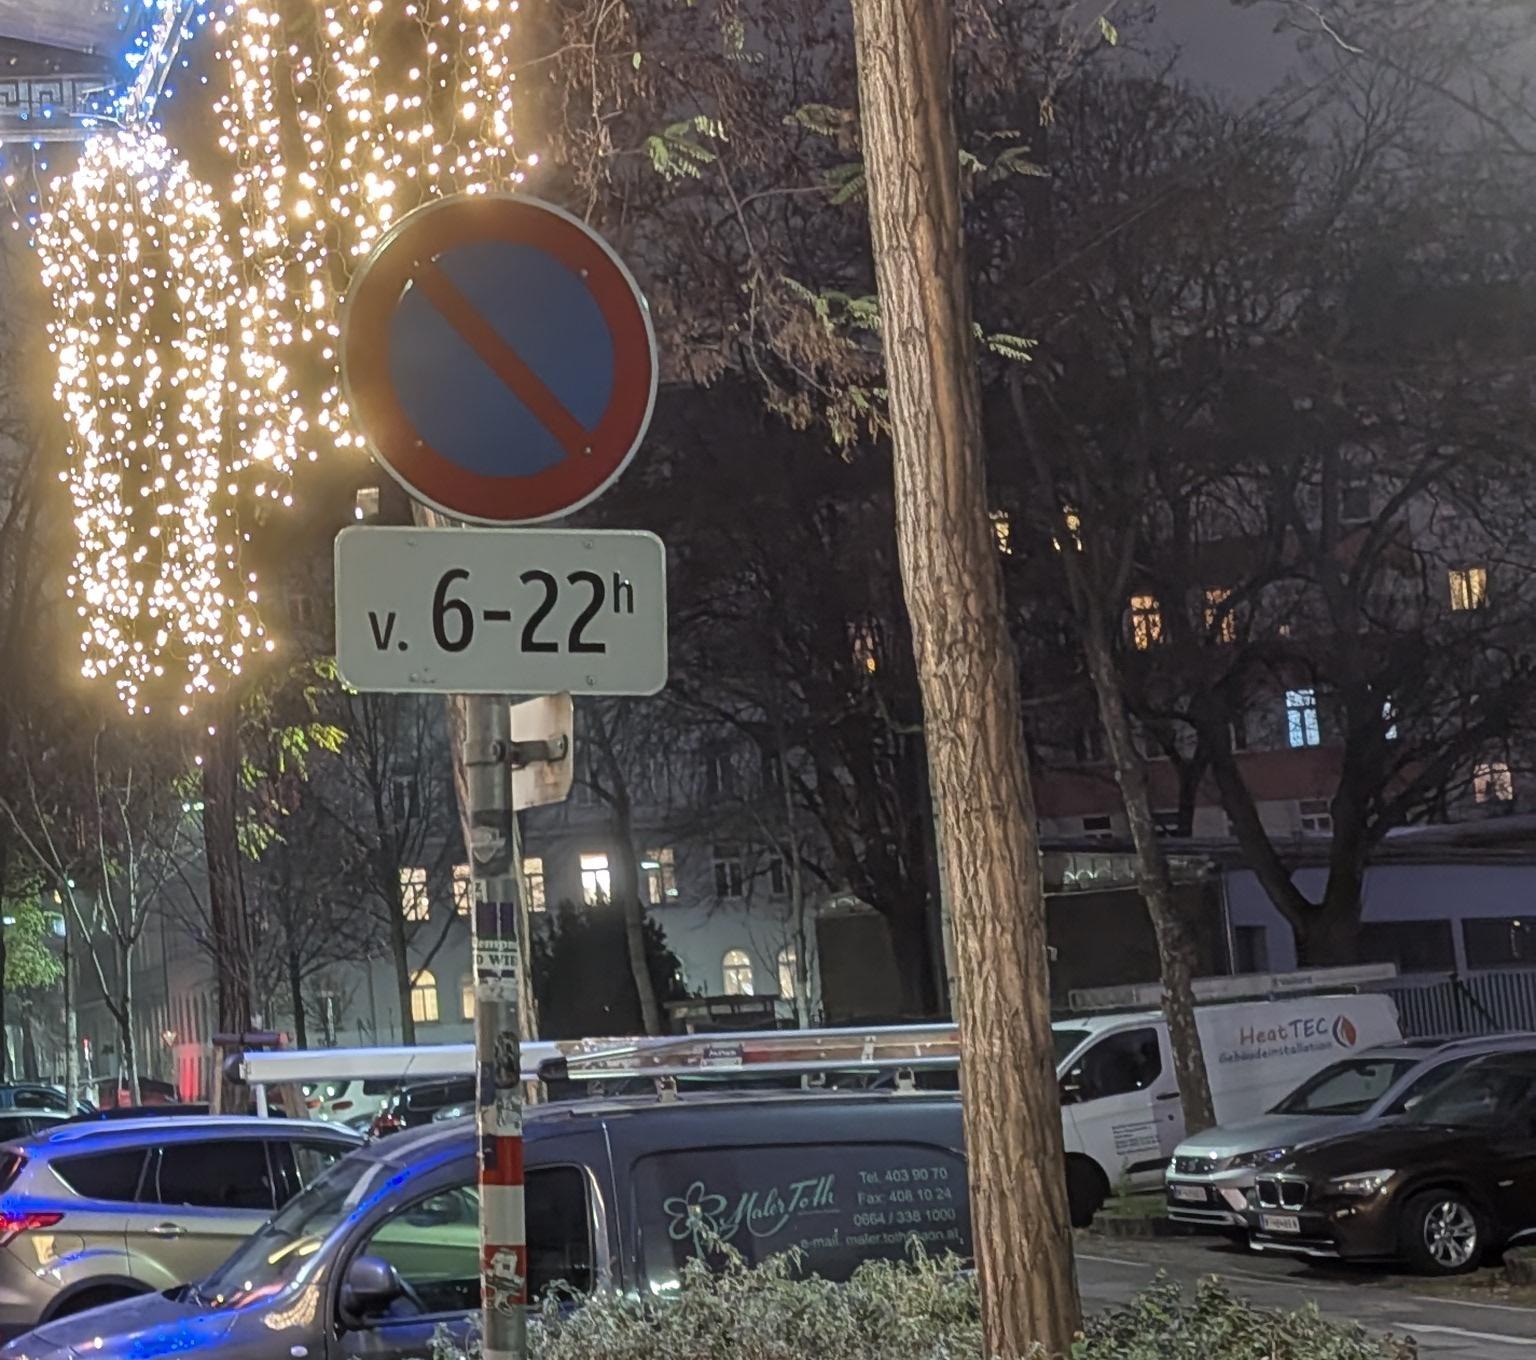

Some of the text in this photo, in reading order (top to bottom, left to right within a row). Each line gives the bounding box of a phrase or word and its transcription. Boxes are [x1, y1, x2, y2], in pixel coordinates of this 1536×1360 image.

[368, 611, 409, 652] v.
[885, 1169, 909, 1182] 403
[931, 1167, 948, 1180] 70
[917, 1188, 933, 1201] 10
[936, 1187, 952, 1200] 24
[926, 1207, 956, 1222] 1000
